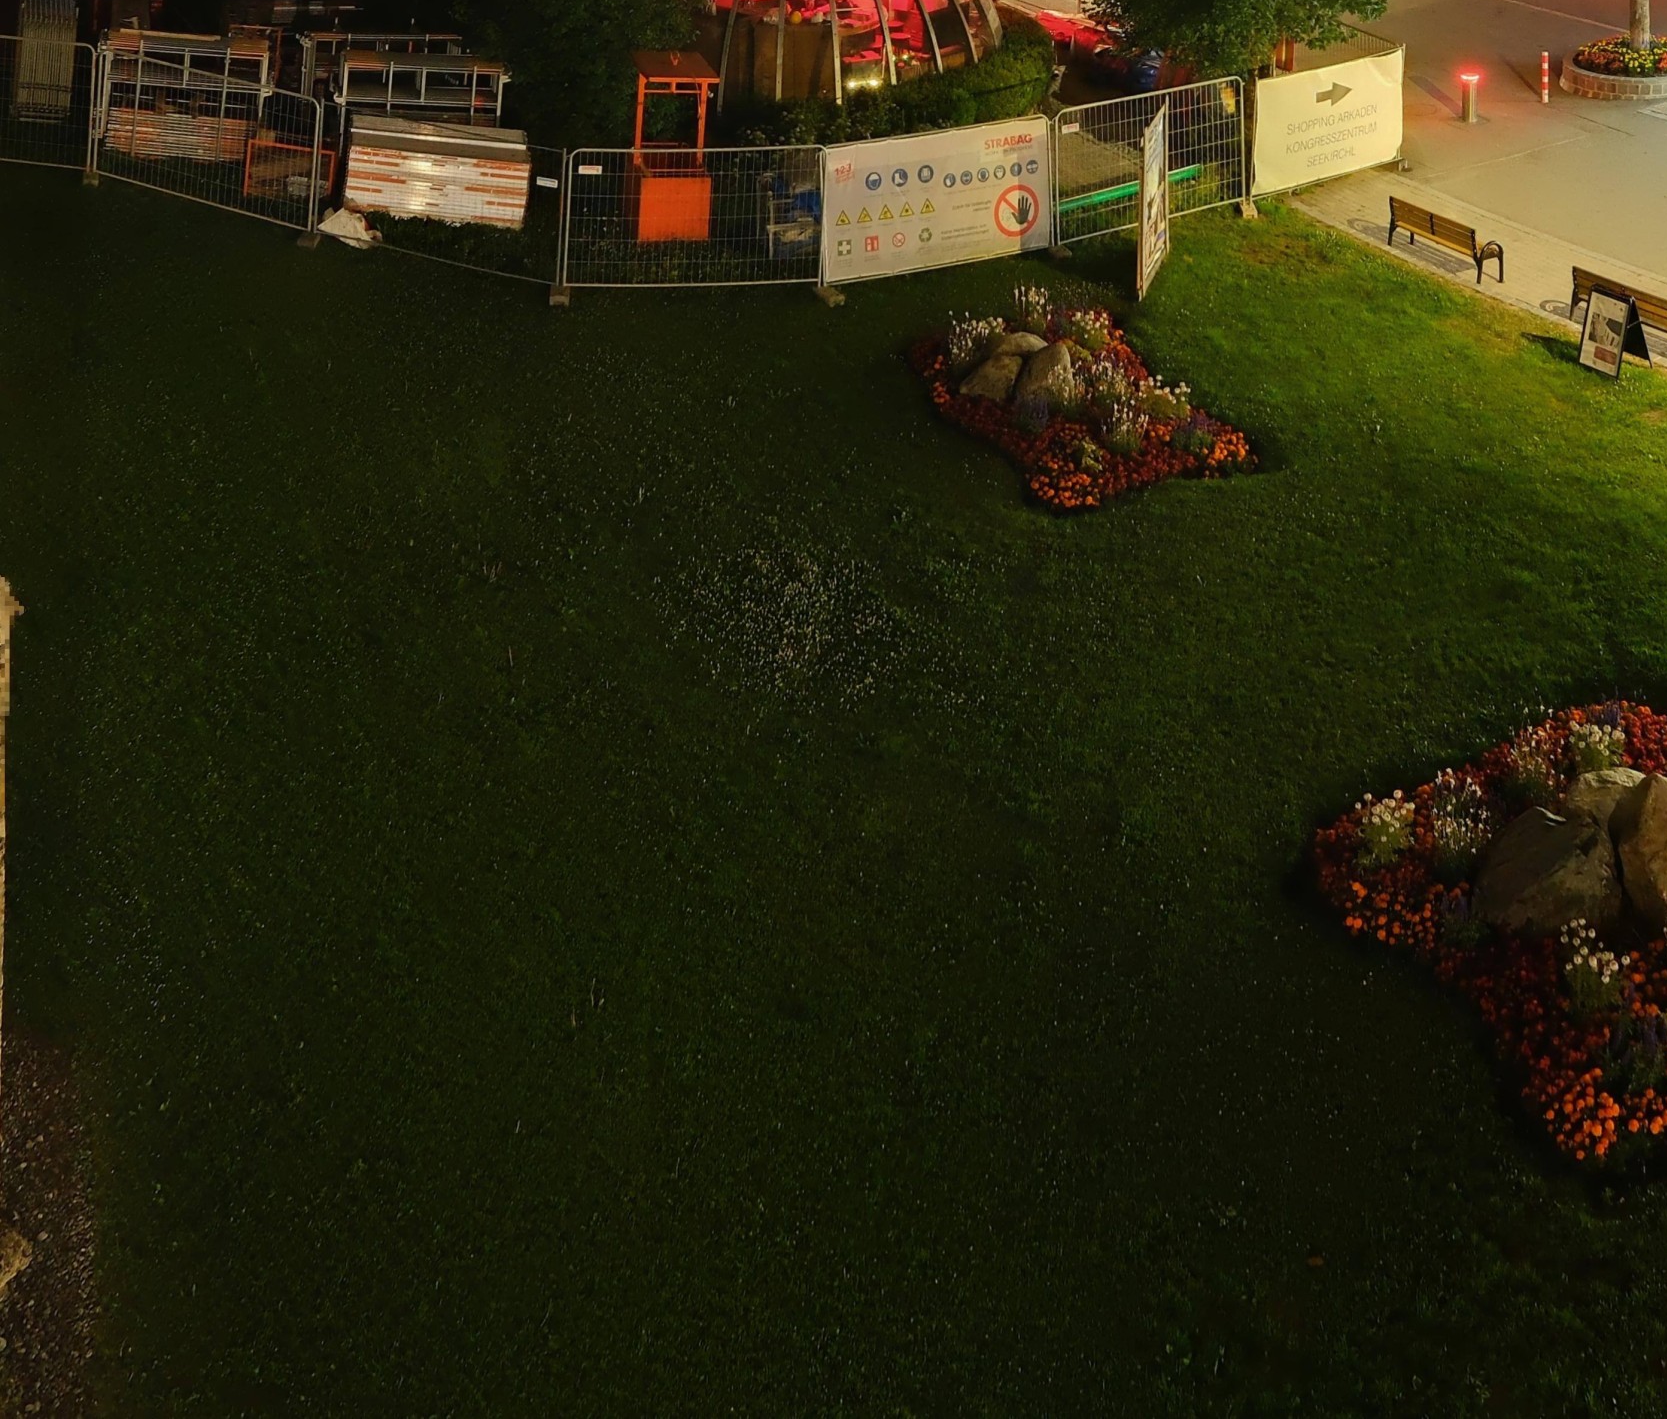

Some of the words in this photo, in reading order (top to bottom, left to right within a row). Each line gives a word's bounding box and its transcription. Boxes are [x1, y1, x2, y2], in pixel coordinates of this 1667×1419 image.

[1286, 114, 1335, 136] SHOPPING
[1337, 104, 1378, 123] ARKADEN
[984, 133, 1033, 150] STRABAG
[1286, 121, 1378, 154] KONGRESSZENTRUM
